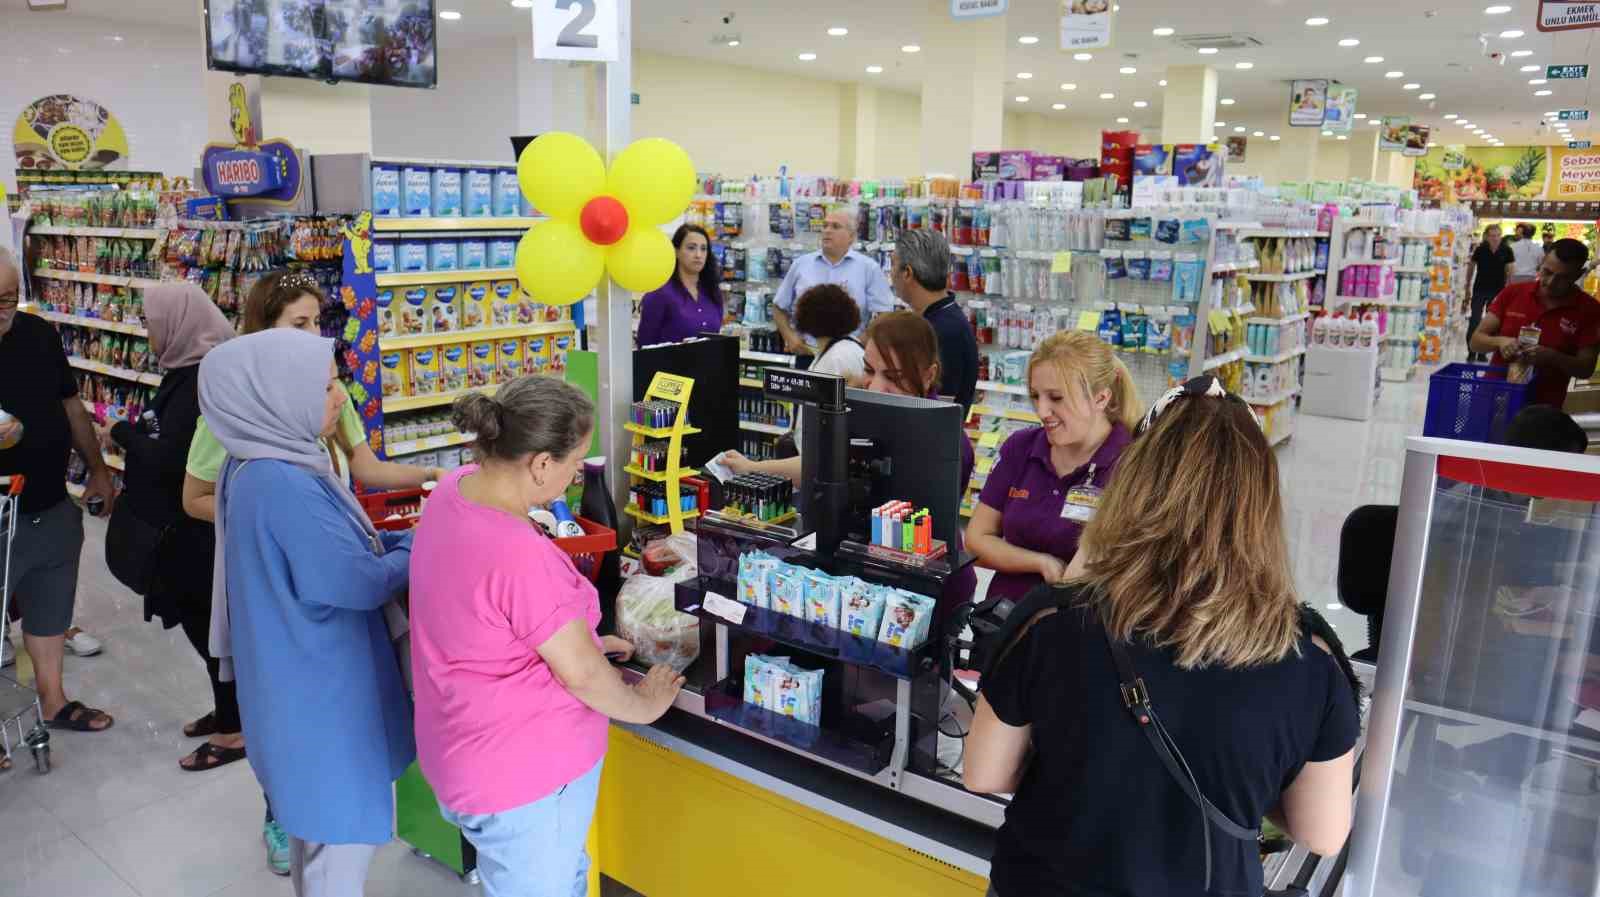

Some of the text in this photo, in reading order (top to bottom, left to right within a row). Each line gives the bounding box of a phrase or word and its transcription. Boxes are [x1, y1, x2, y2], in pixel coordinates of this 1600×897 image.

[1567, 5, 1594, 14] EKMEK
[554, 0, 599, 49] 2
[216, 159, 260, 185] HARIBO
